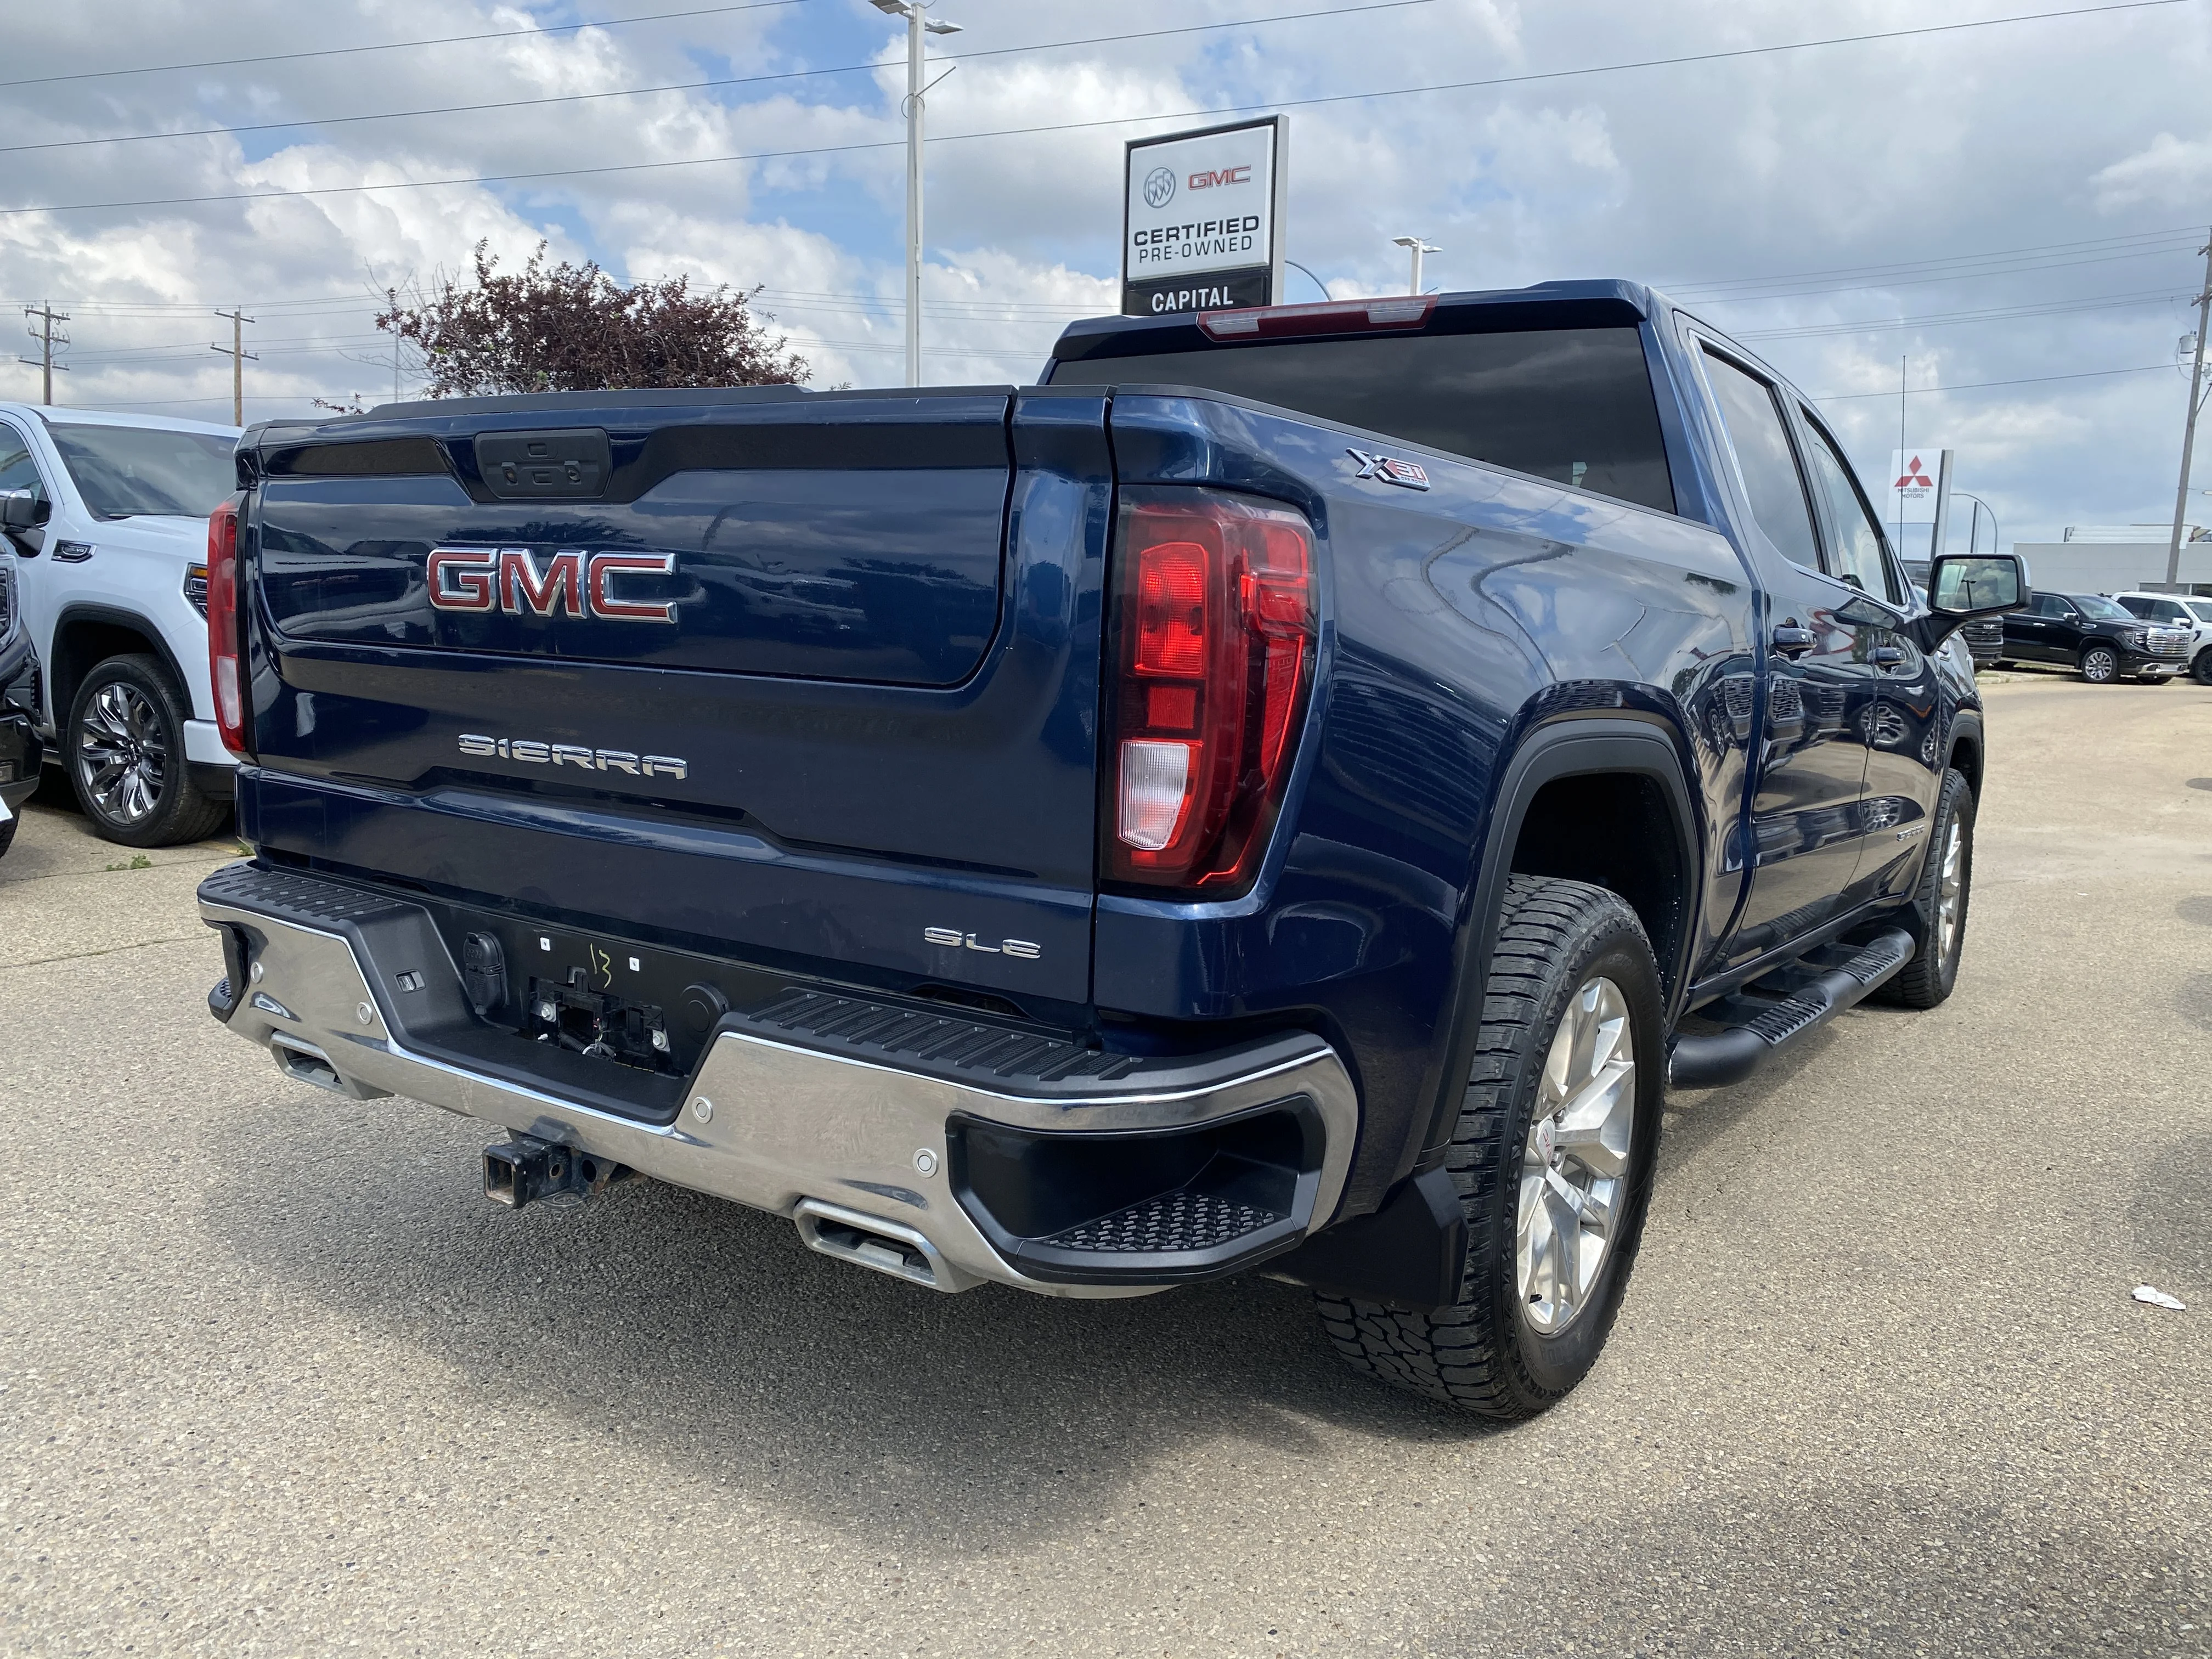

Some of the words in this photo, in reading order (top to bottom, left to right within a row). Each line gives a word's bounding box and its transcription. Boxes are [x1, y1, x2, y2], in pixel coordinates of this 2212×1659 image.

[1188, 164, 1251, 191] GMC
[1133, 215, 1260, 246] CERTIFIED
[1139, 235, 1252, 263] PRE-OWNED
[1152, 285, 1234, 312] CAPITAL
[426, 546, 680, 624] GMC
[458, 733, 688, 780] SIERRA
[924, 927, 1041, 959] SLE
[589, 942, 612, 989] 13
